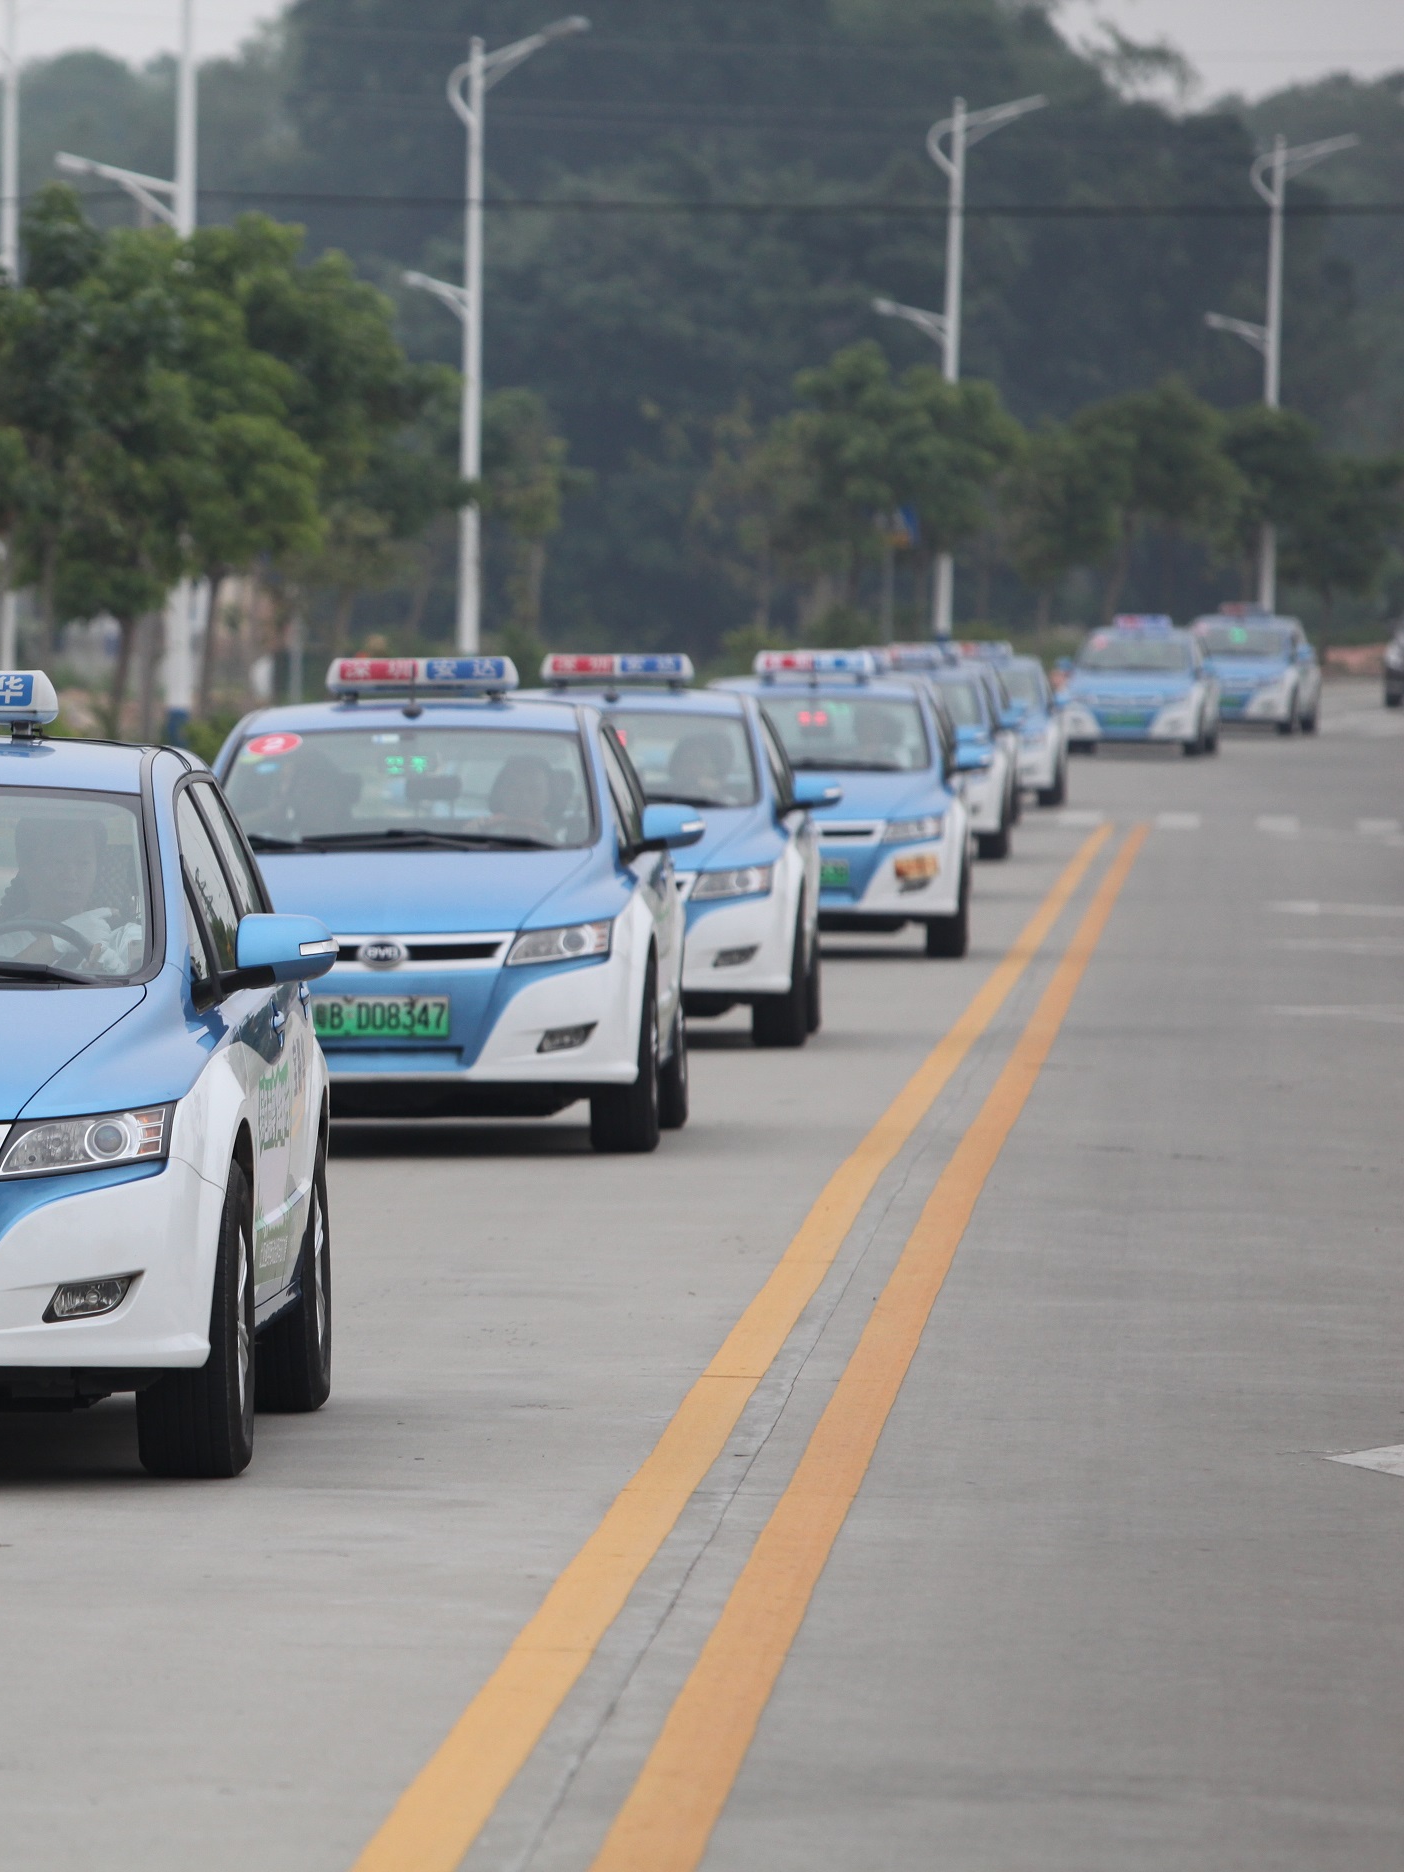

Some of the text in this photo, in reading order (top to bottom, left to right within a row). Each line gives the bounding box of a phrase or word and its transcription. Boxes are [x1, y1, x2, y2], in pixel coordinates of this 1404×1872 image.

[345, 659, 497, 679] 深圳 安达
[357, 1003, 445, 1029] D08347
